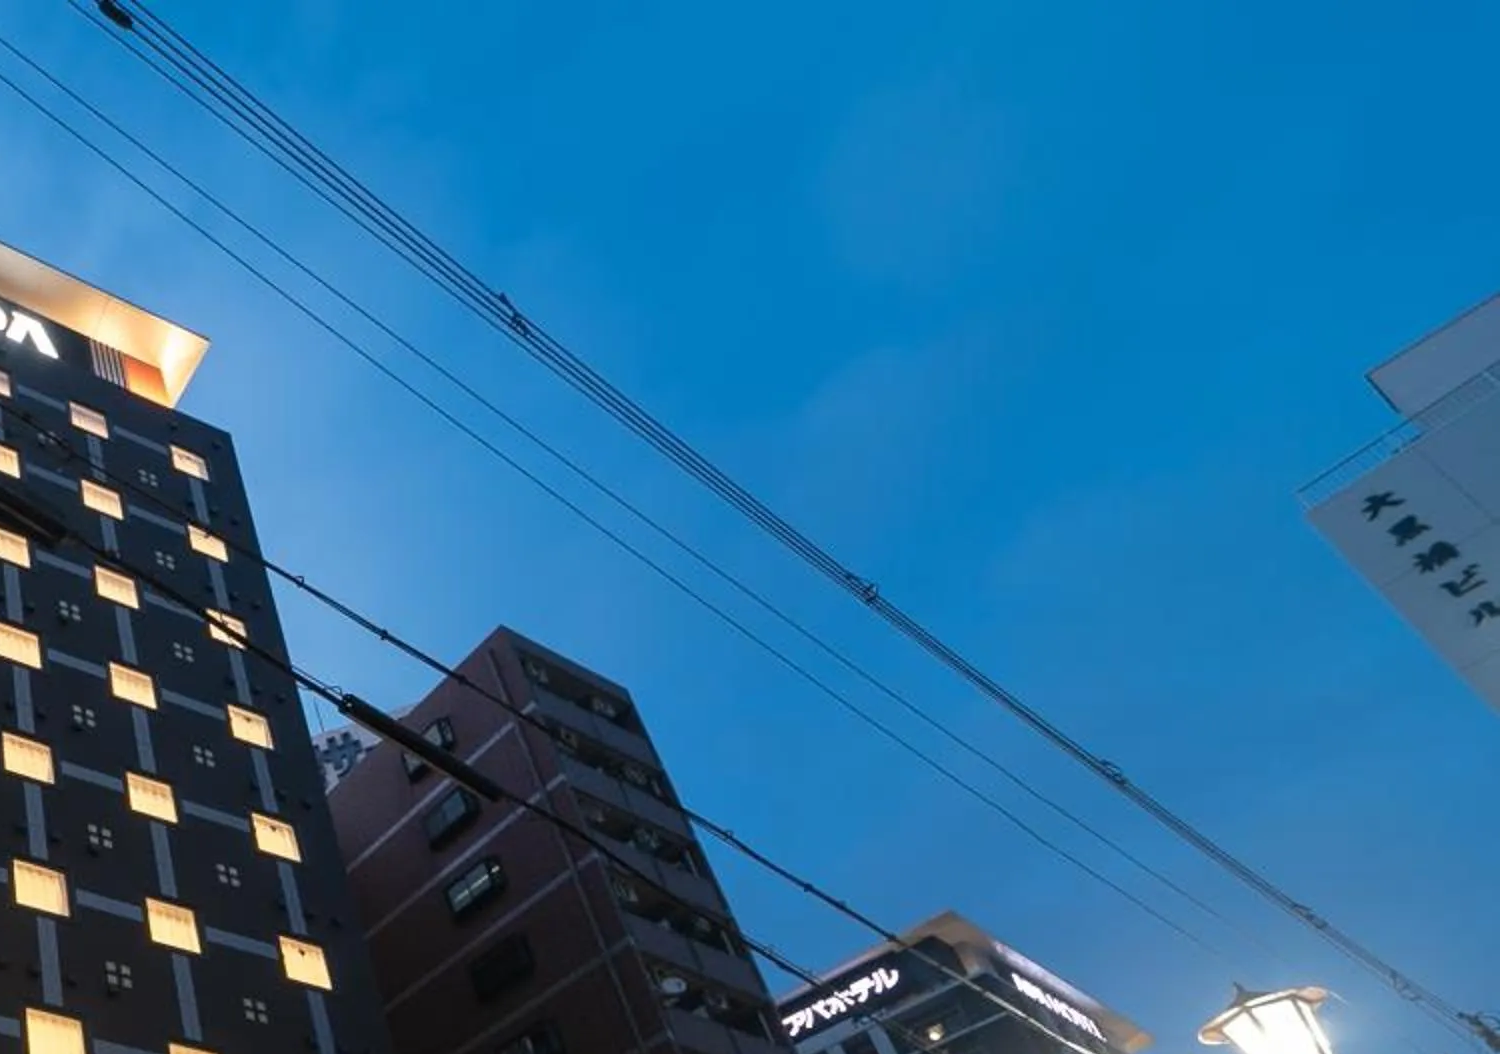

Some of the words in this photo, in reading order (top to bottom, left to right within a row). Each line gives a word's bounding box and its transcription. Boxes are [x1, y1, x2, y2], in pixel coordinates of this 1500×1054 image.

[781, 967, 899, 1037] アパホテル
